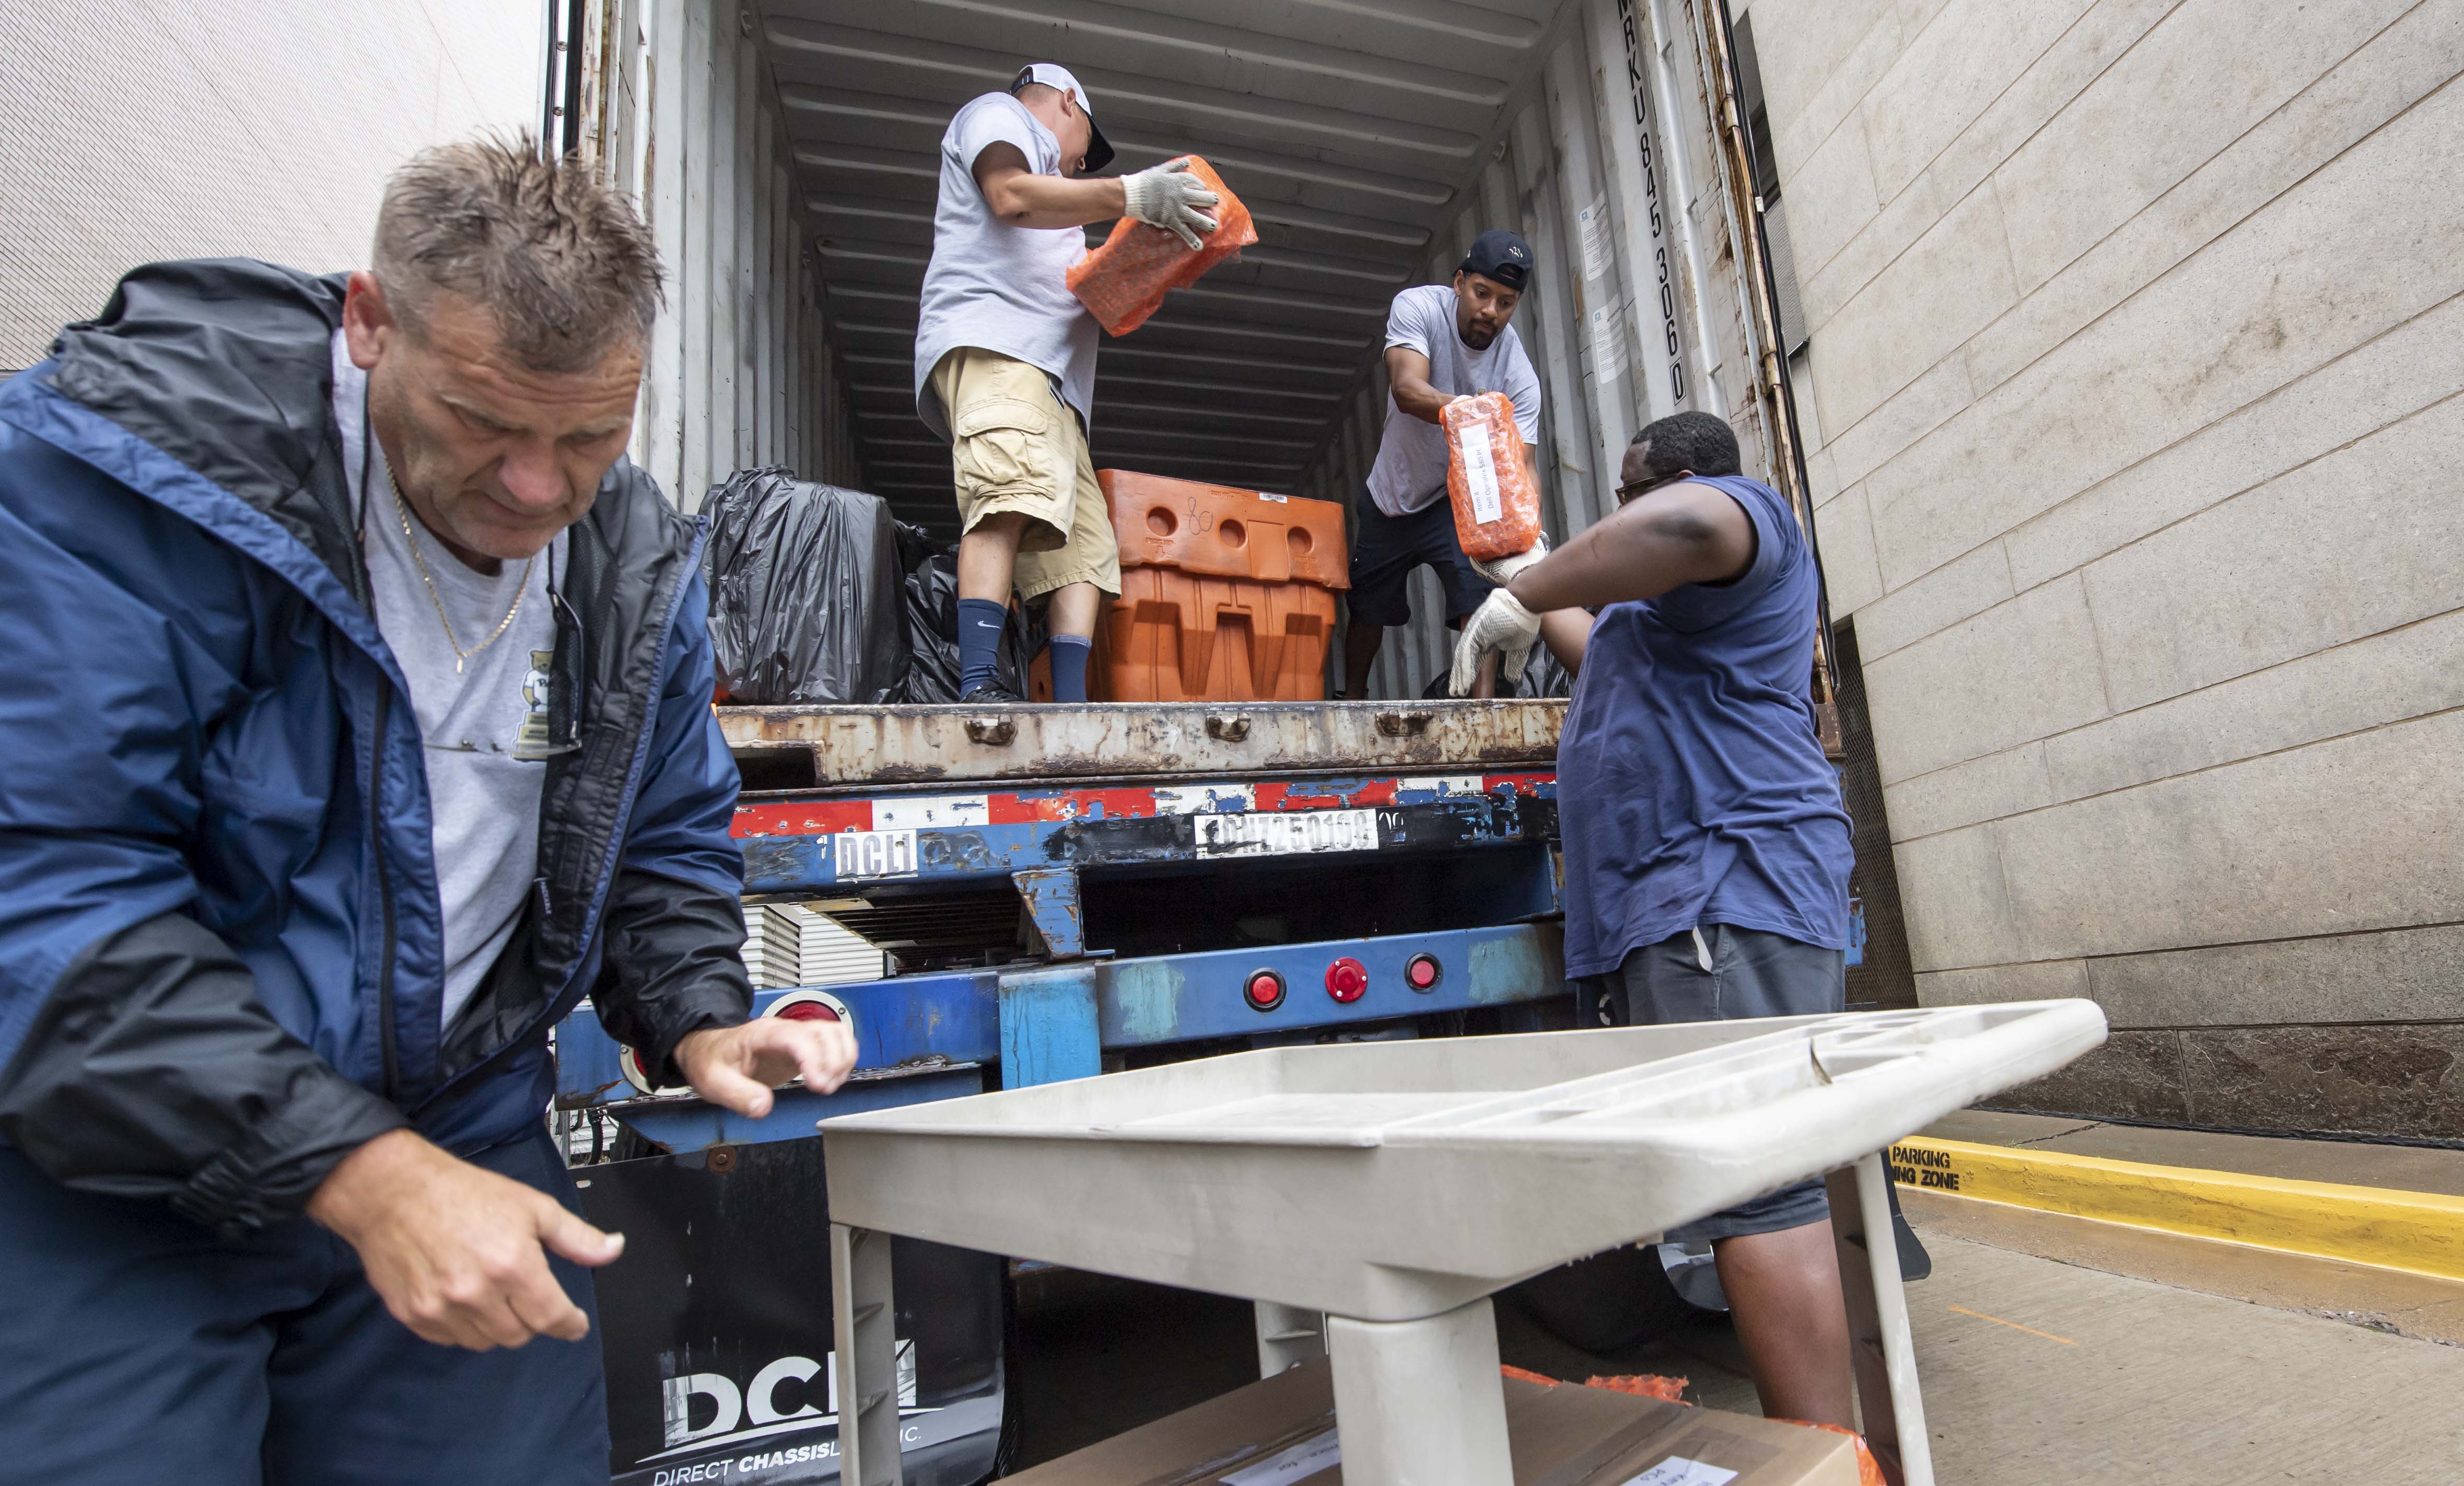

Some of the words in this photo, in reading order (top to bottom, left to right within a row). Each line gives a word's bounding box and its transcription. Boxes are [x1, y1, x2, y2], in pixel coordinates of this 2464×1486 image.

[1640, 132, 1662, 238] 845
[1486, 496, 1494, 509] Dell
[839, 833, 912, 875] DCLI
[1893, 1146, 1951, 1169] PARKING
[1921, 1169, 1959, 1191] ZONE
[663, 1339, 917, 1448] DCI
[654, 1458, 734, 1486] DIRECT
